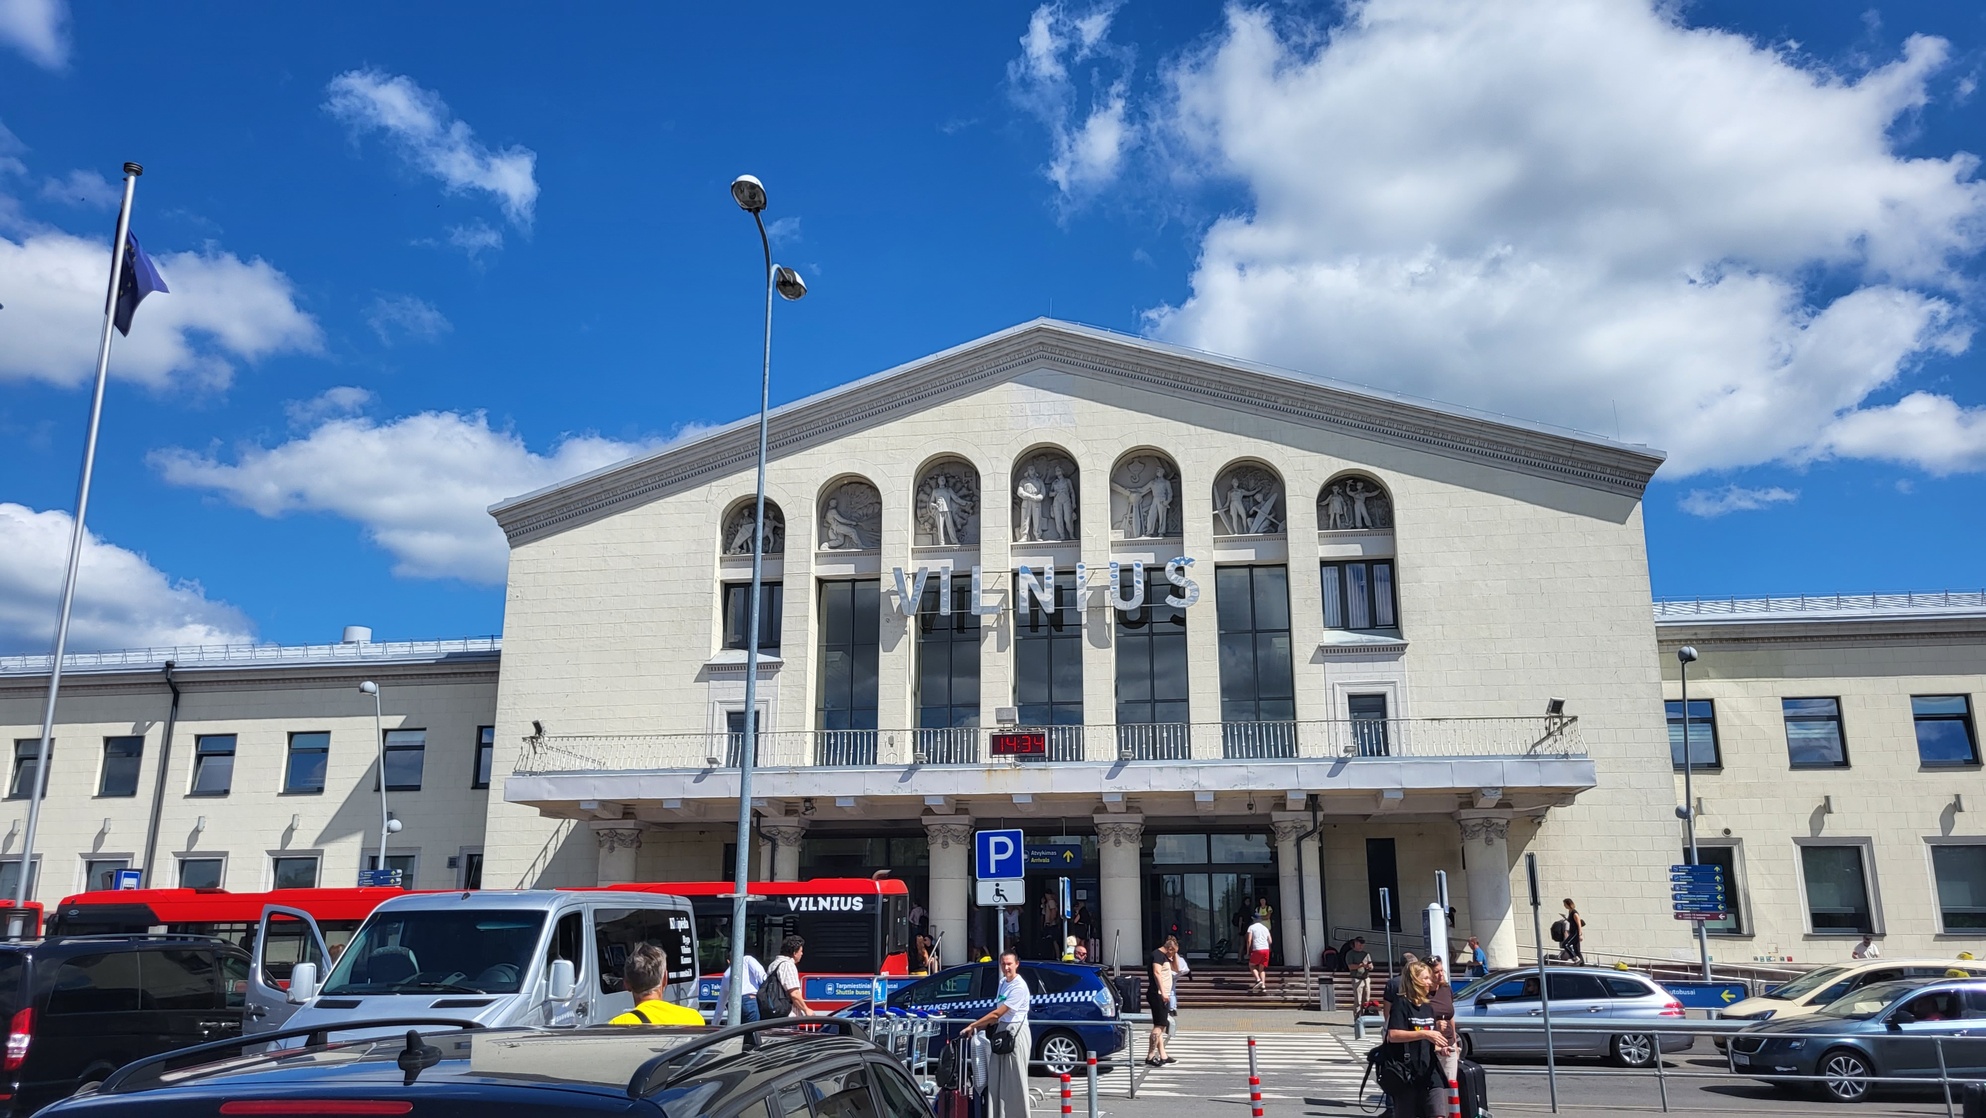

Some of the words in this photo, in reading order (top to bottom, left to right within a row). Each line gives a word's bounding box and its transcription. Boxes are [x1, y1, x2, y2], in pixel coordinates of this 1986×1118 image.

[892, 556, 1200, 616] VILNIUS
[1001, 735, 1044, 752] 14:34
[989, 836, 1014, 874] P
[787, 896, 864, 912] VILNIUS
[923, 1003, 951, 1011] TAKSI
